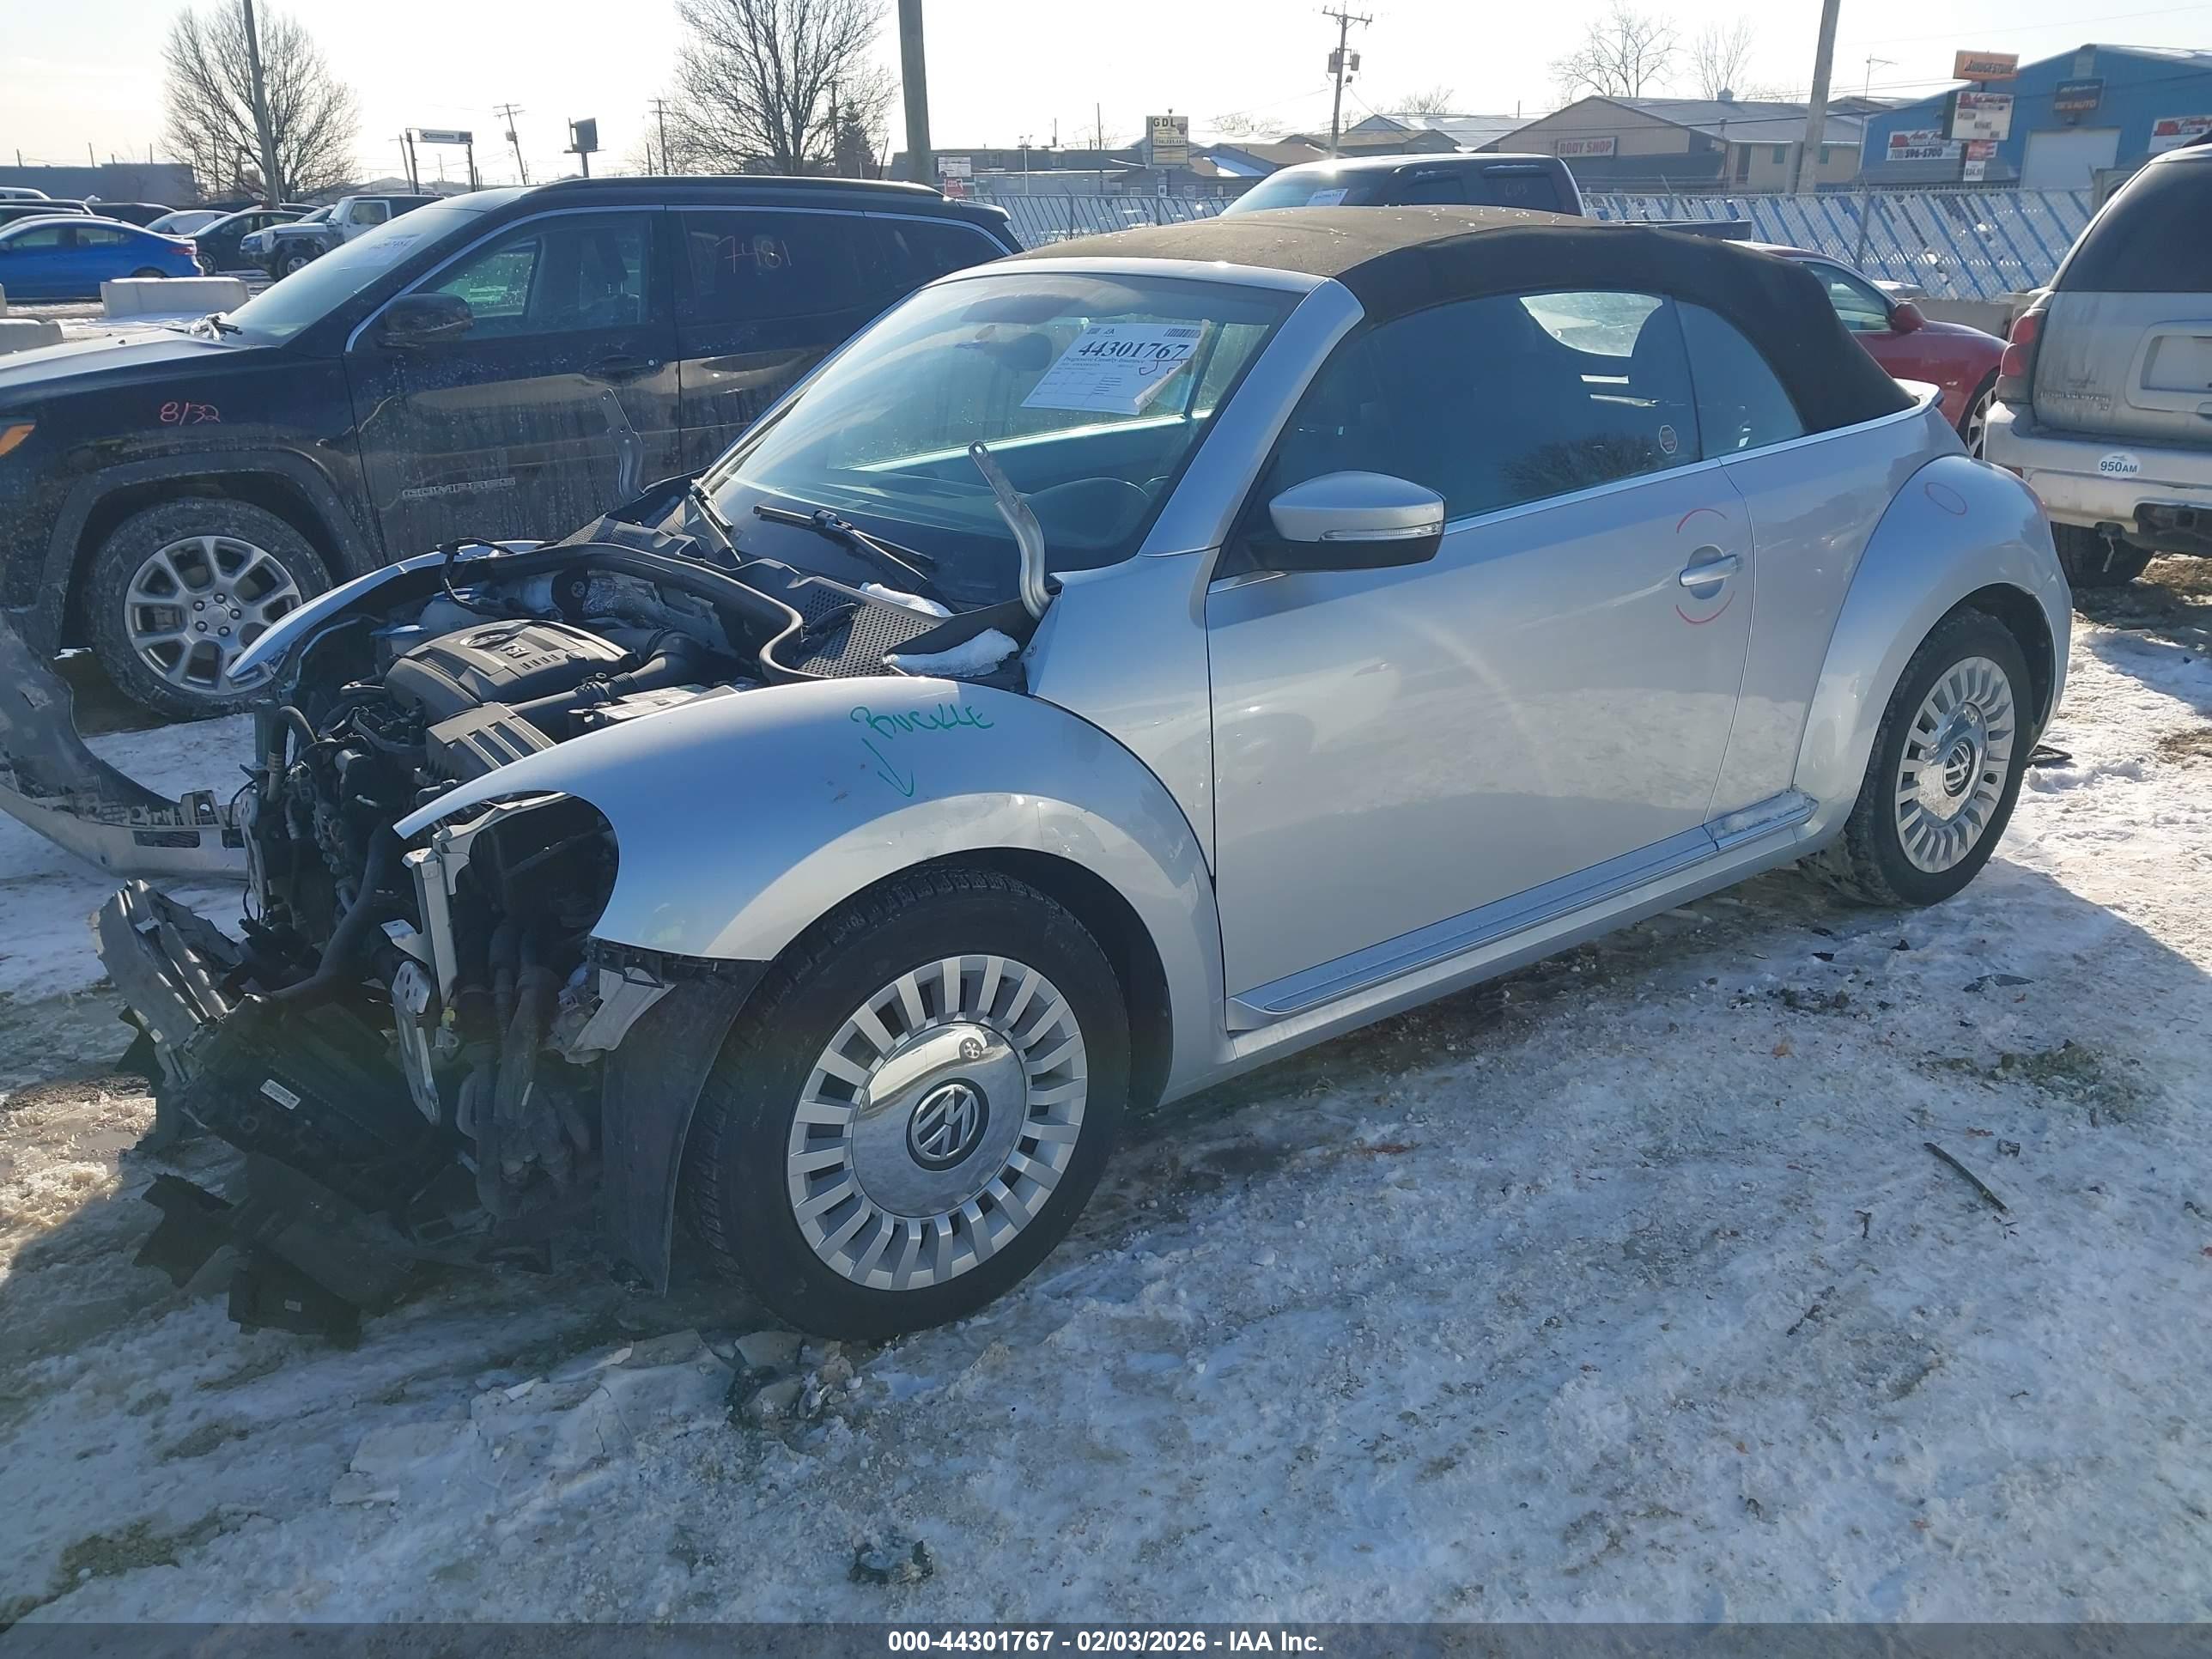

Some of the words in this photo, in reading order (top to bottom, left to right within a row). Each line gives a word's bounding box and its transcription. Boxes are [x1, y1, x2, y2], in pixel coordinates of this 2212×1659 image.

[1153, 117, 1176, 127] GDL
[1559, 142, 1585, 154] BODY
[1586, 140, 1613, 153] SHOP
[1079, 341, 1189, 359] 44301767
[501, 642, 532, 659] TSI
